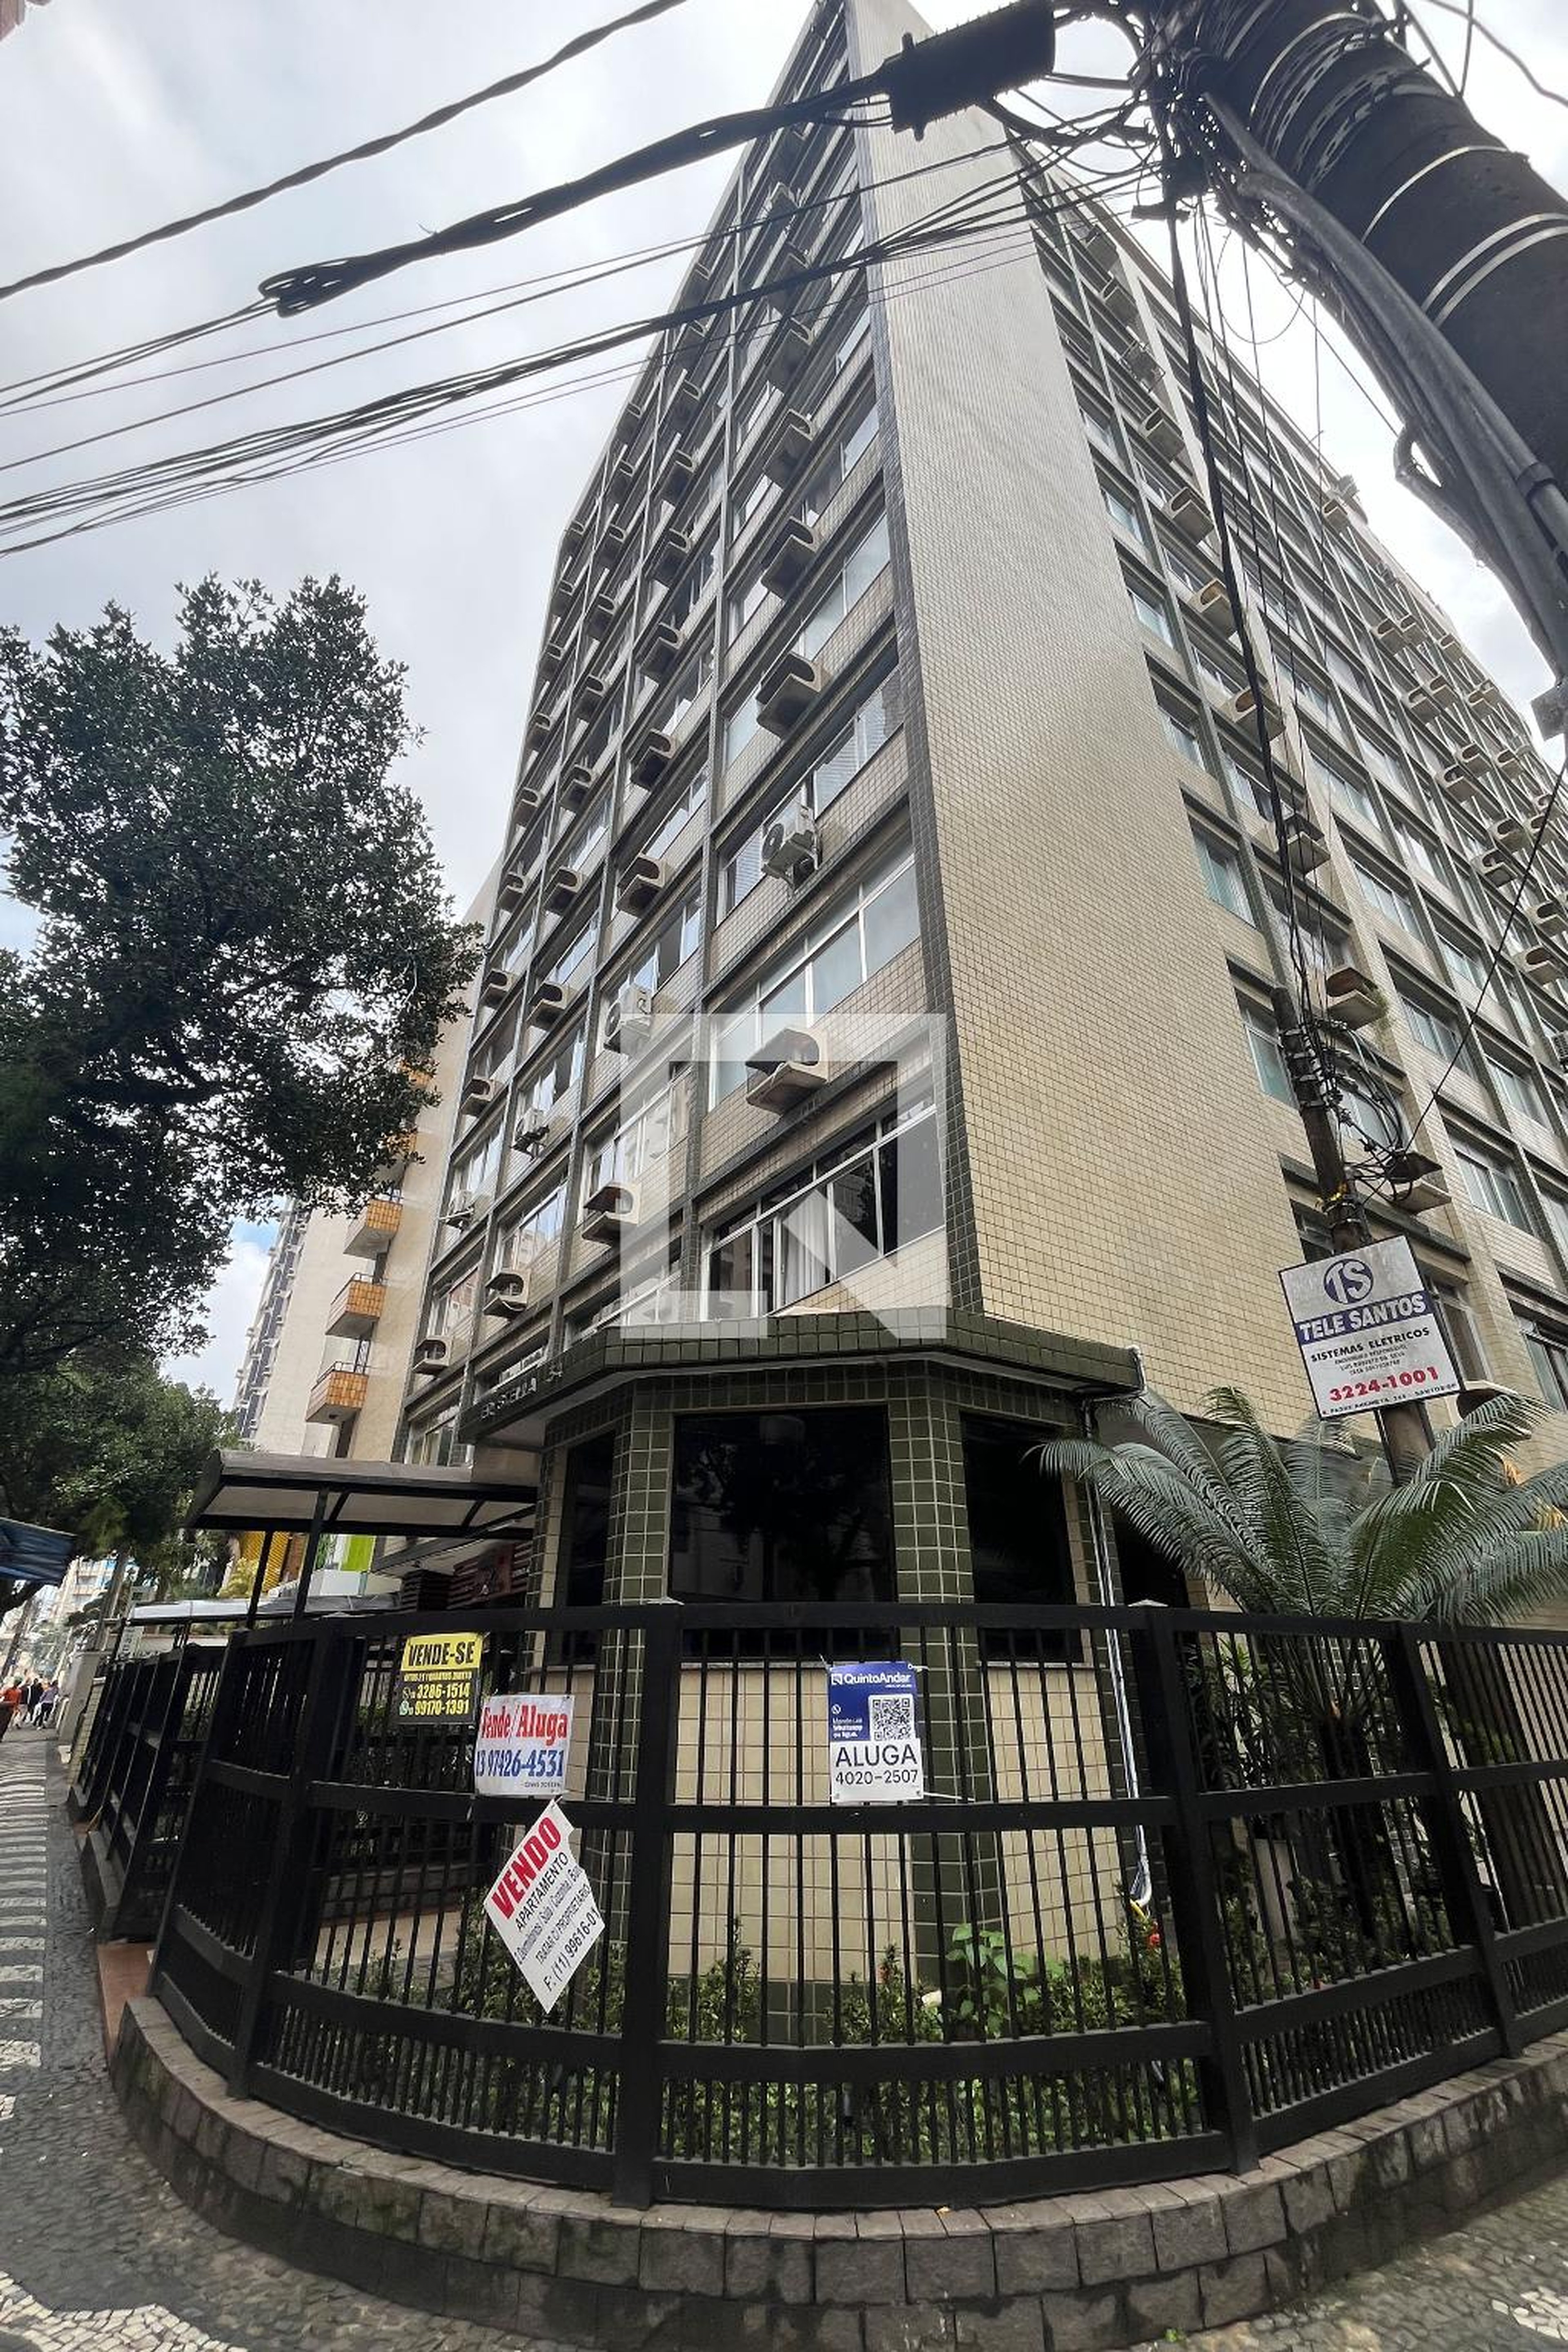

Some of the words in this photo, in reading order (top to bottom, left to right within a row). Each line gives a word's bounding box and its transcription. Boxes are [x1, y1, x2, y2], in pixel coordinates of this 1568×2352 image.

[1299, 1316, 1345, 1341] TELE
[1348, 1293, 1426, 1330] SANTOS
[1311, 1343, 1364, 1362] SISTEMAS
[1330, 1366, 1439, 1401] 3224-1001
[408, 1641, 475, 1666] VENDE-SE
[844, 1672, 911, 1685] QuintoAndar
[516, 1705, 568, 1746] Aluga
[835, 1744, 918, 1767] ALUGA
[835, 1770, 918, 1785] 4020-2507
[491, 1817, 561, 1920] VENDO
[515, 1852, 569, 1932] APARTAMENTO
